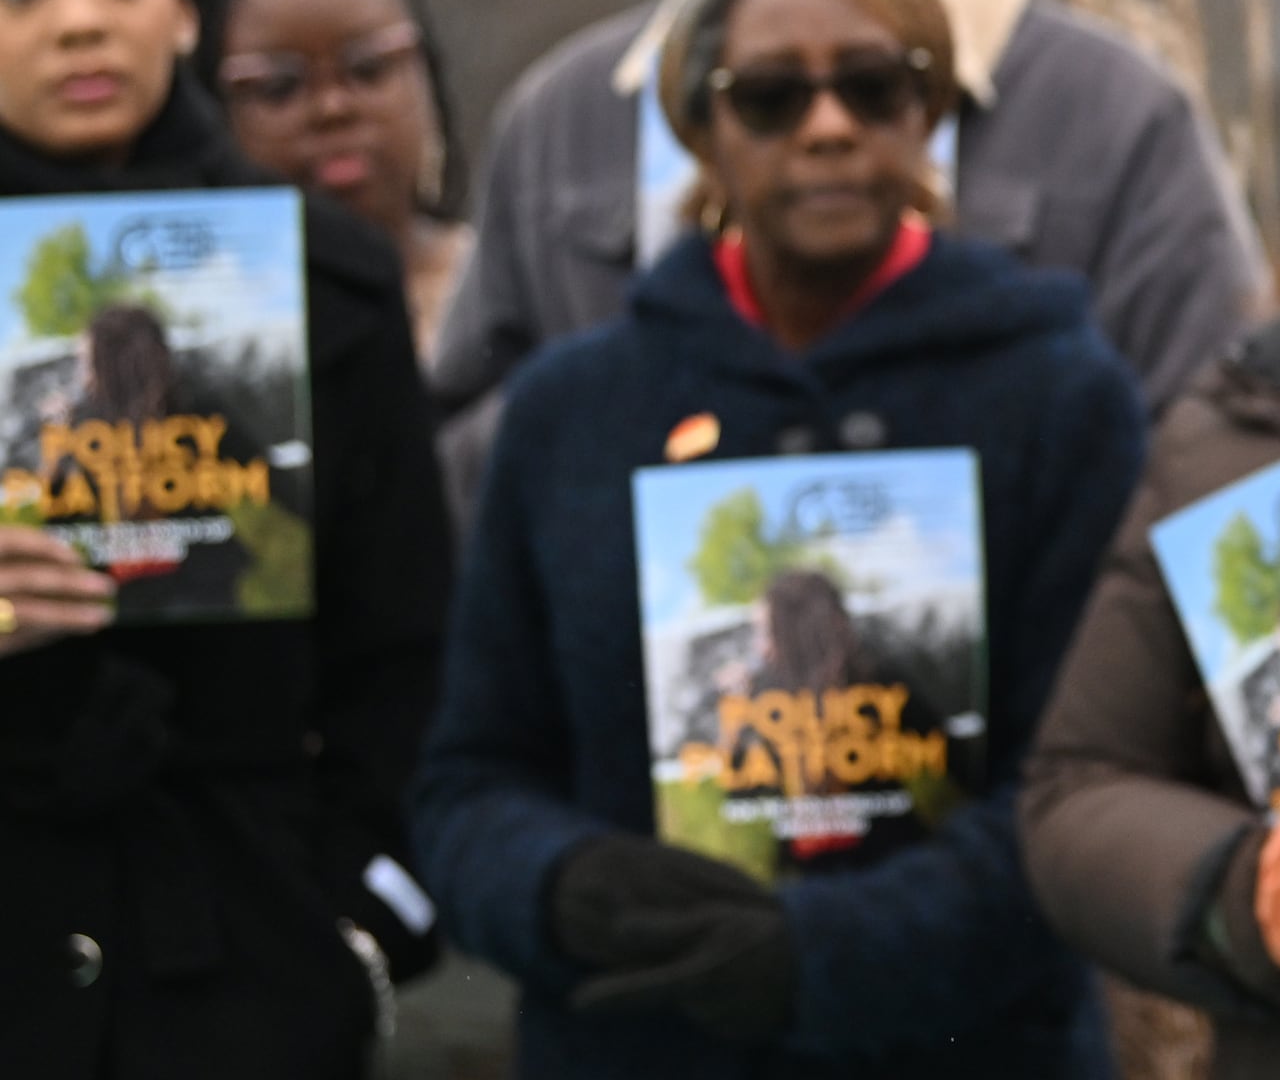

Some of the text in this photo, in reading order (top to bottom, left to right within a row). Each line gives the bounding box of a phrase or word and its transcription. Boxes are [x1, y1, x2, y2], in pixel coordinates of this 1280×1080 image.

[41, 415, 226, 477] POLICY
[2, 457, 270, 525] PLATFORM
[718, 683, 909, 749] POLICY
[679, 728, 948, 794] PLATFORM
